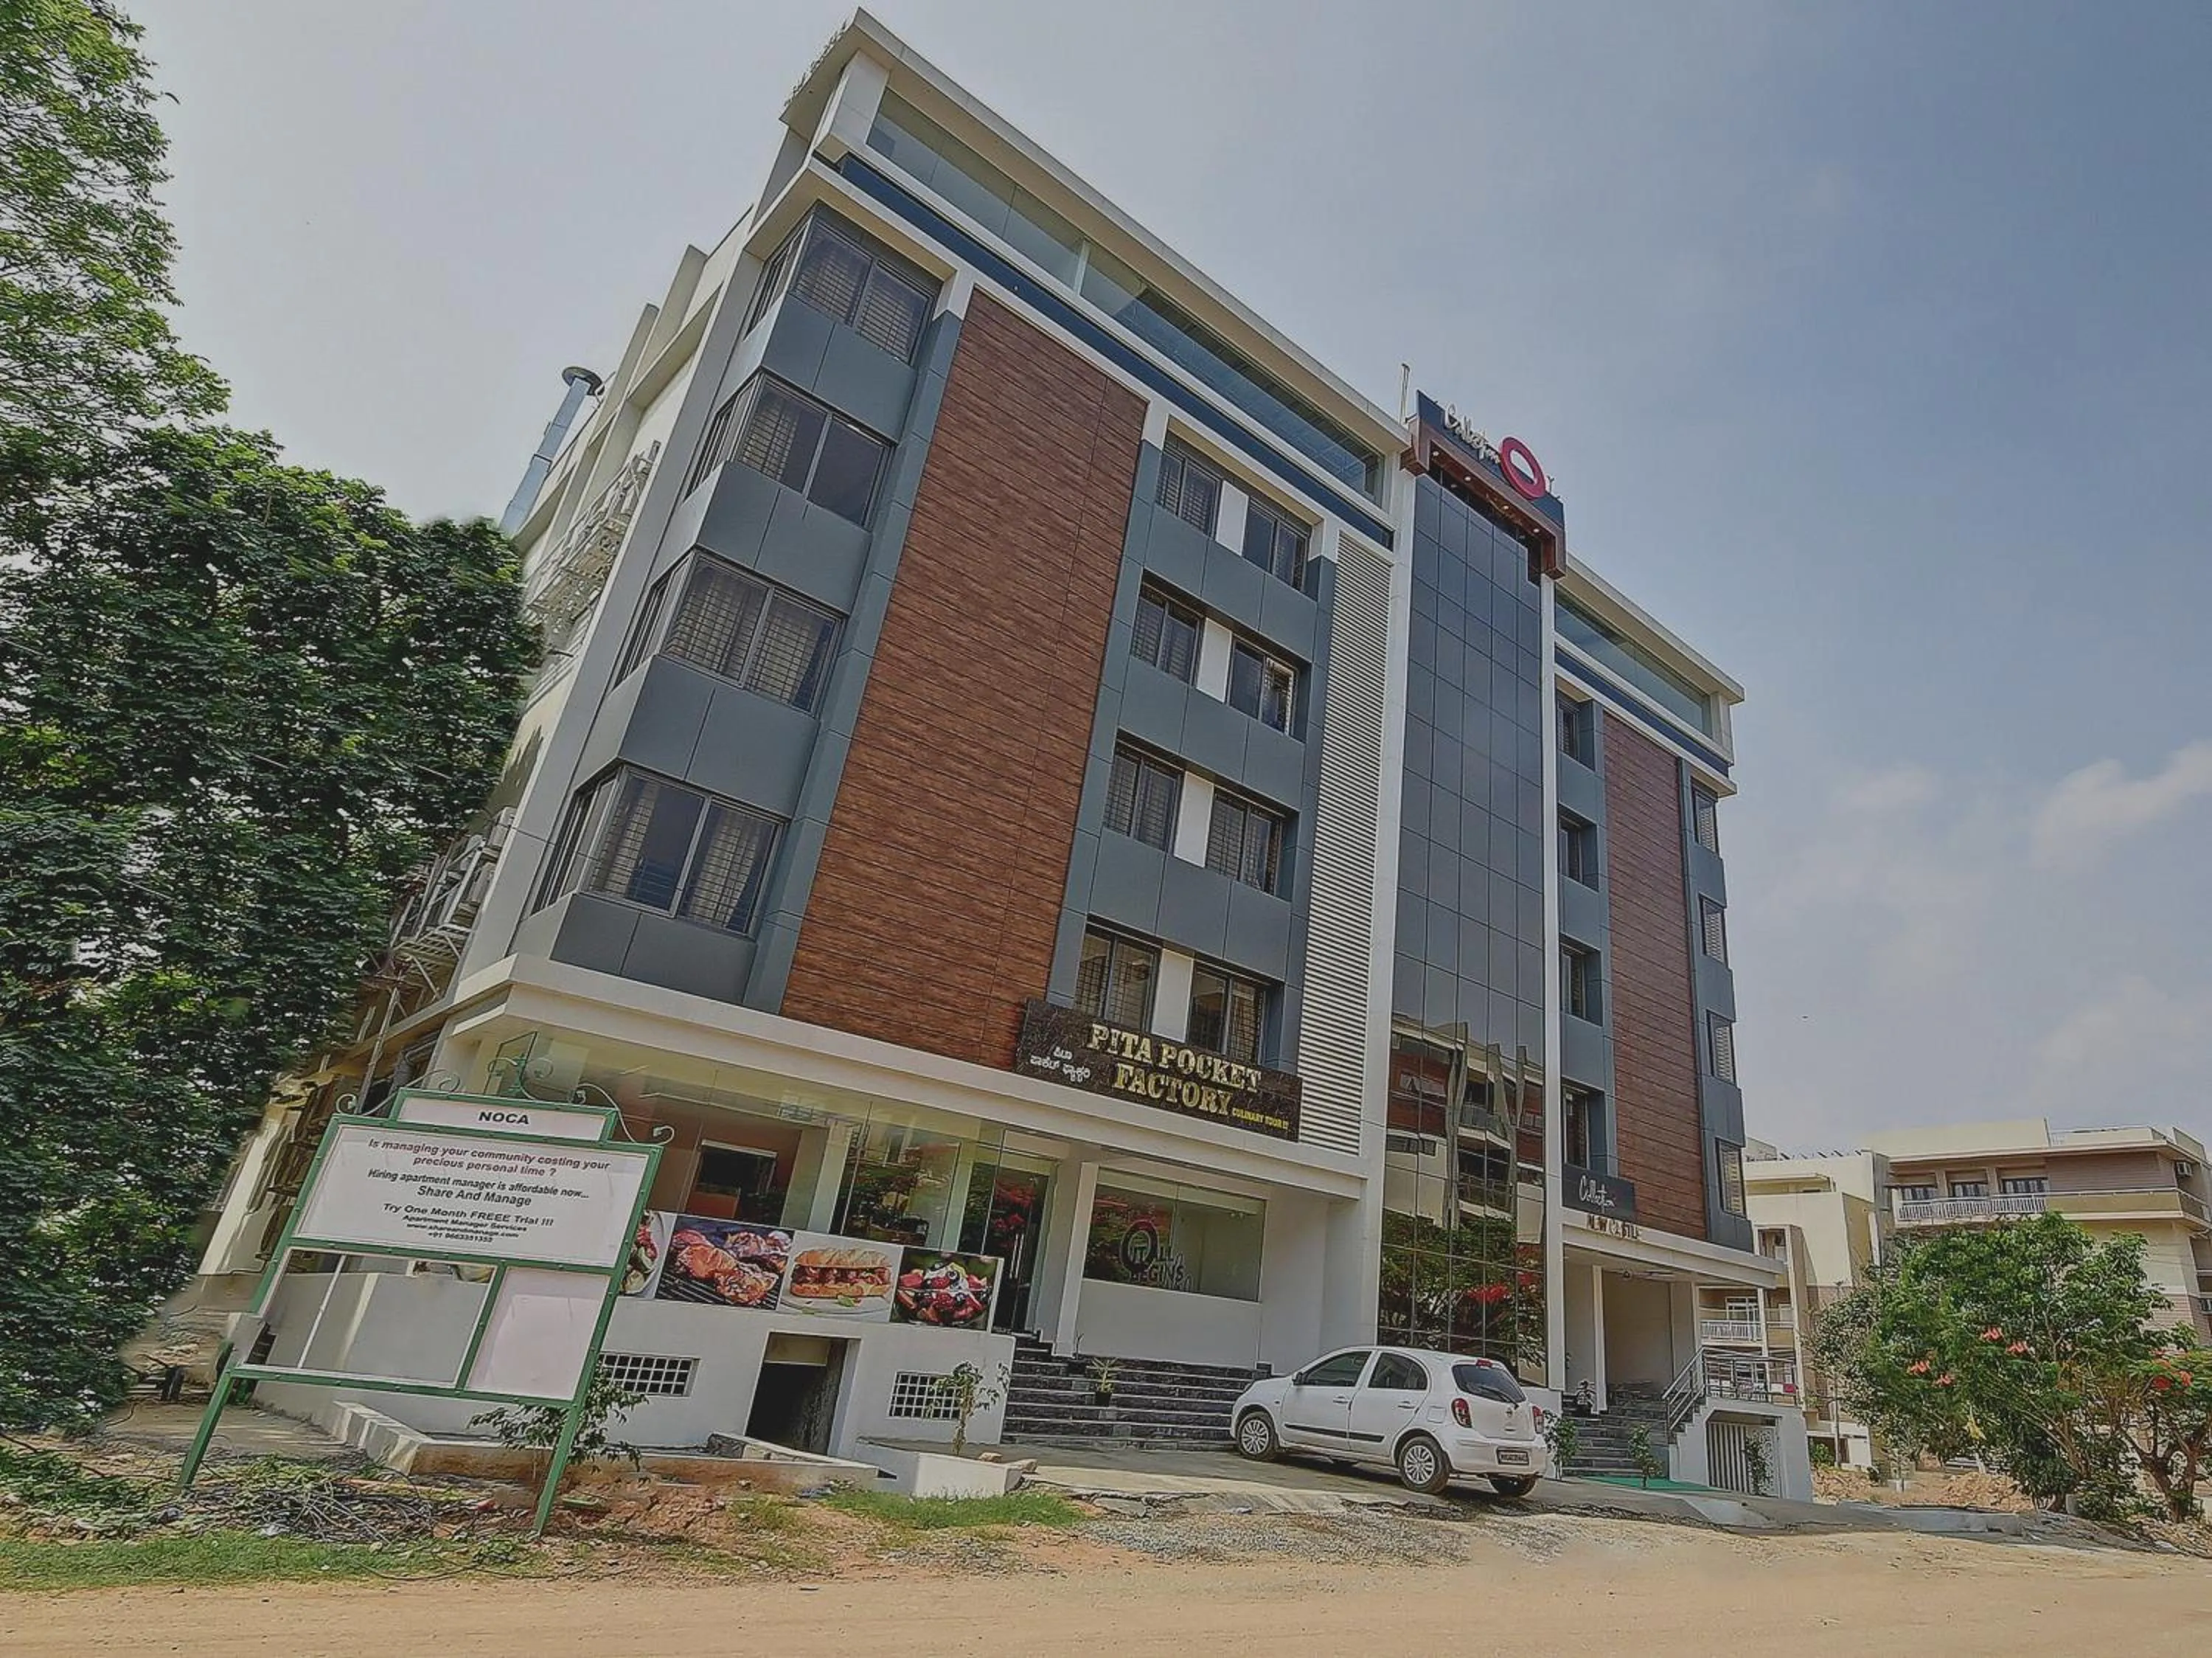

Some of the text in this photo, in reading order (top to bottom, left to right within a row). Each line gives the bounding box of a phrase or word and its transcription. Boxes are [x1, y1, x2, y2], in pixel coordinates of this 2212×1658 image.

[1087, 1023, 1262, 1092] PITA POCKET
[1112, 1063, 1233, 1115] FACTORY
[479, 1111, 529, 1125] NOCA
[369, 1138, 611, 1170] Is managing your community costing your
[413, 1156, 464, 1168] precious
[466, 1164, 518, 1173] personal
[520, 1165, 545, 1176] time
[368, 1168, 398, 1182] Hiring
[399, 1173, 451, 1185] apartment
[451, 1179, 495, 1190] manager
[496, 1182, 506, 1190] is
[508, 1182, 558, 1196] affordable
[417, 1185, 532, 1207] Share And Manage
[383, 1203, 402, 1213] Try
[404, 1204, 428, 1214] One
[430, 1207, 467, 1218] Month
[514, 1215, 539, 1225] Trial
[402, 1215, 527, 1232] Apartment Manager Services
[1587, 1214, 1608, 1233] NEW
